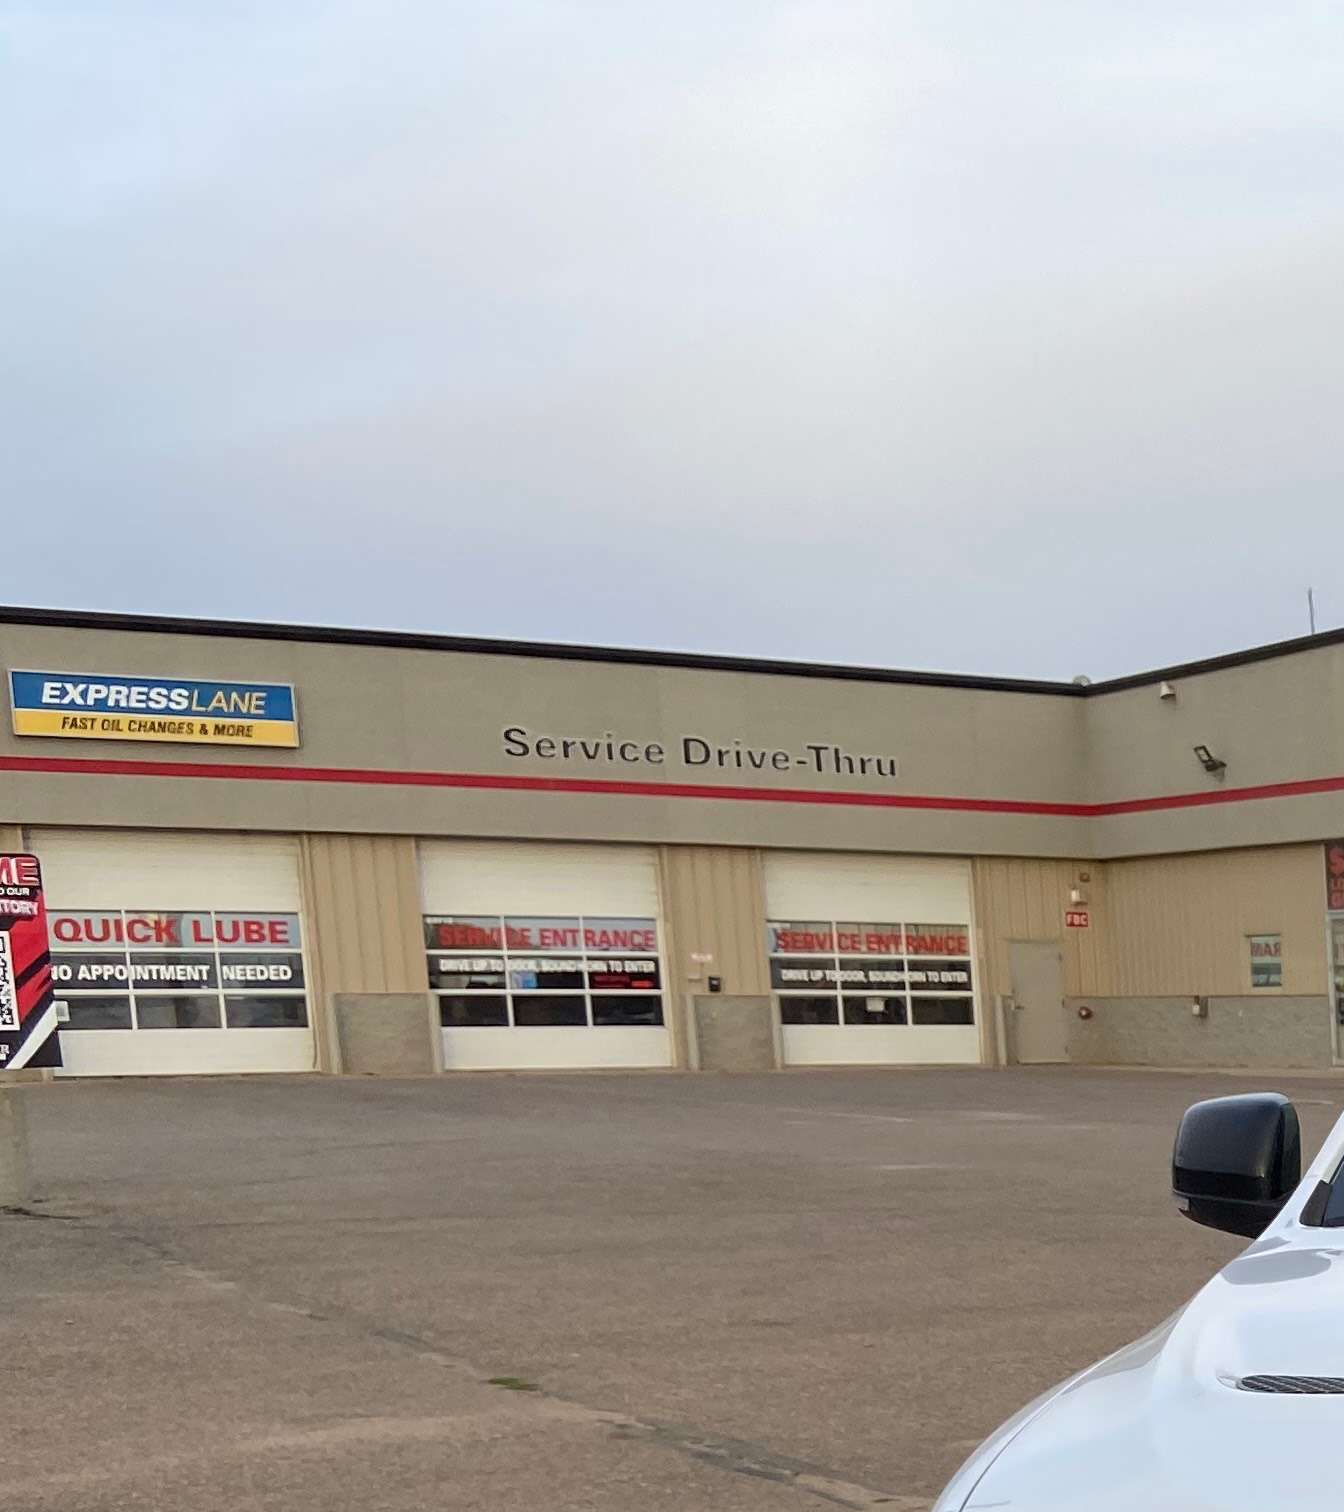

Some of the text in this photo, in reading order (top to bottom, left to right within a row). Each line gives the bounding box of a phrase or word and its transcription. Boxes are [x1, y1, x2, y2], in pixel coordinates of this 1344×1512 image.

[61, 716, 254, 738] FAST OIL CHANGES & MORE
[503, 726, 898, 777] Service Drive-Thru
[53, 917, 290, 945] QUICK LUBE
[439, 926, 656, 949] SERVICE ENTRANCE
[778, 931, 968, 953] SERVICE ENTRANCE
[78, 964, 210, 981] APPOINTMENT
[222, 964, 292, 981] NEEDED
